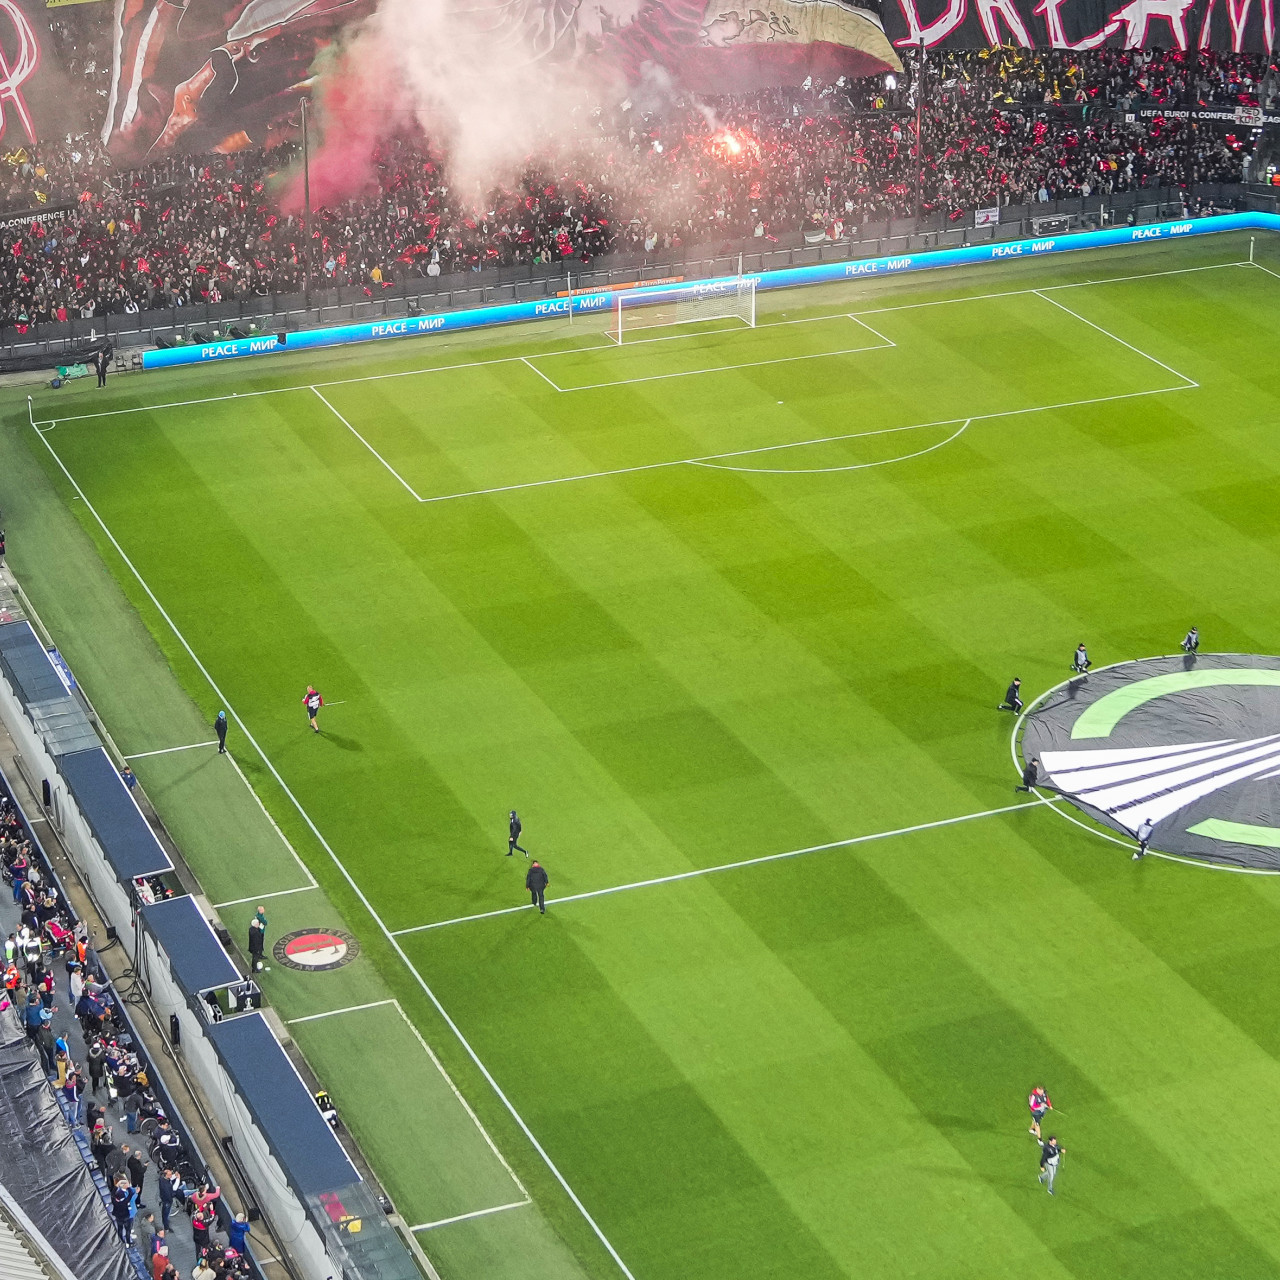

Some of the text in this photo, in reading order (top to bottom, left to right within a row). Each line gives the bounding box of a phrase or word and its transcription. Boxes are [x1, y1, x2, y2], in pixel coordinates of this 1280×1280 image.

[1140, 110, 1162, 118] UEFA
[7, 209, 66, 227] CONFERENCE
[992, 243, 1023, 257] PEACE
[846, 261, 878, 275] PEACE
[535, 301, 570, 315] PEACE
[372, 321, 409, 336] PEACE
[201, 343, 238, 359] PEACE
